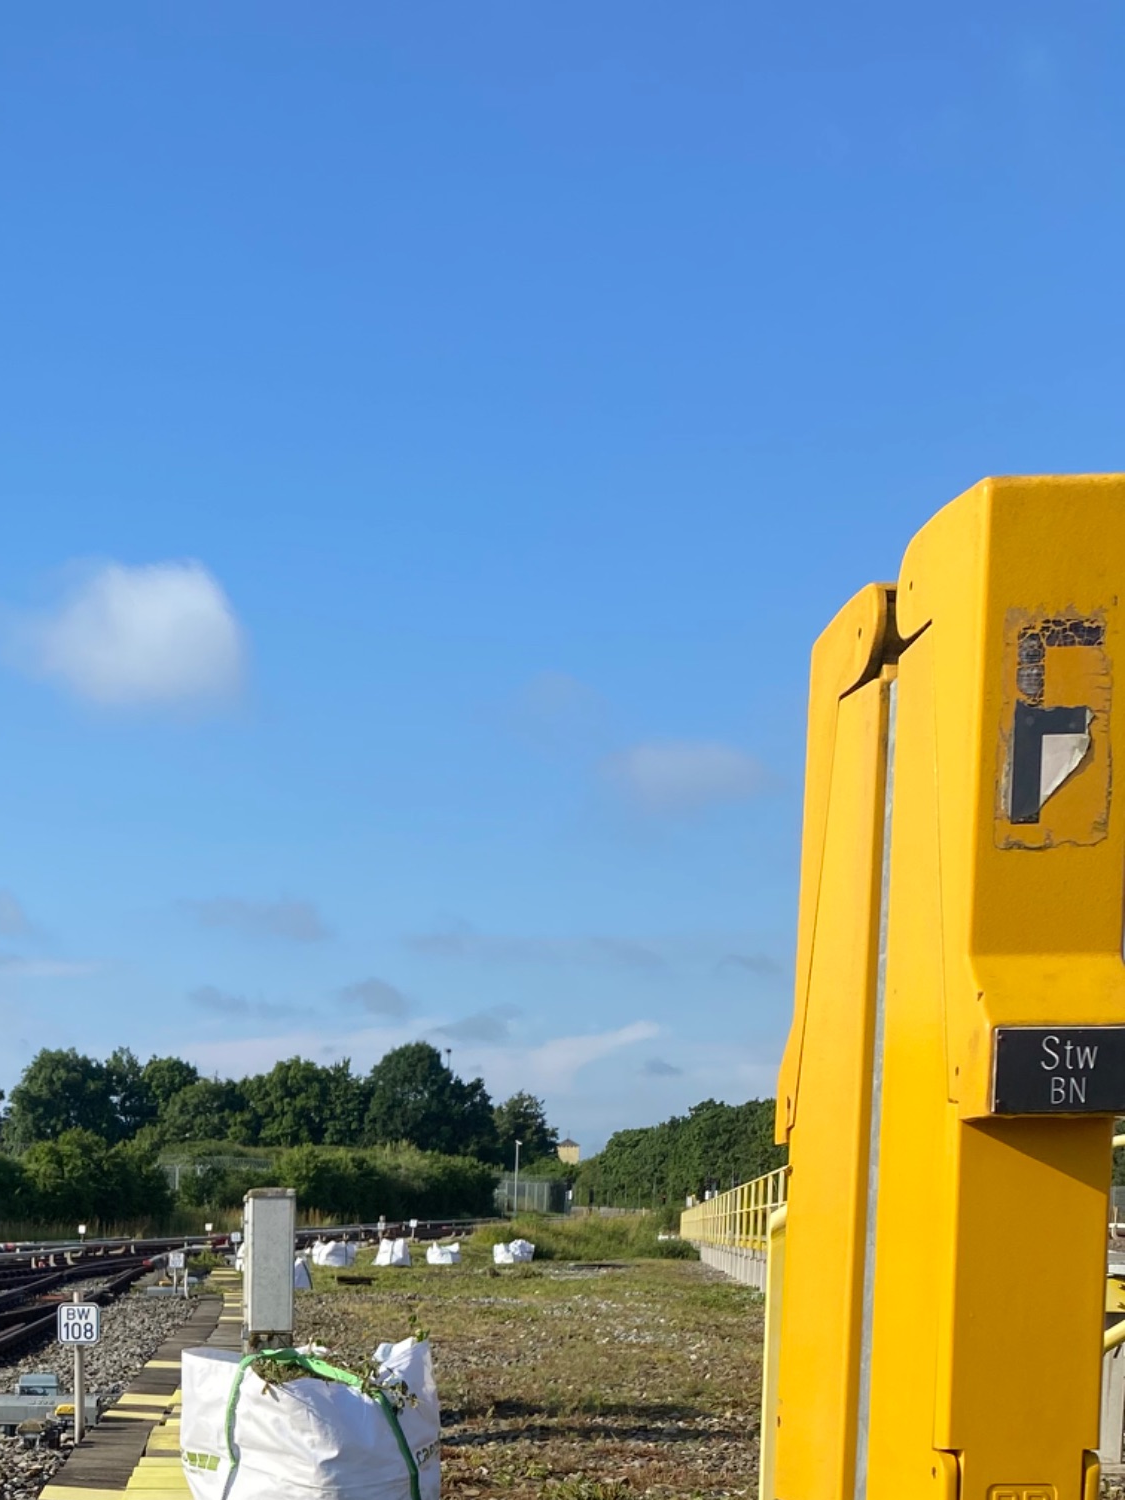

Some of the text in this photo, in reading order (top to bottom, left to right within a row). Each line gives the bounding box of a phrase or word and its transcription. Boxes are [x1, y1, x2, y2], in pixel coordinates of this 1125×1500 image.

[1040, 1035, 1099, 1071] Stw
[1050, 1076, 1087, 1105] BN
[66, 1307, 91, 1321] BW
[63, 1322, 95, 1340] 108
